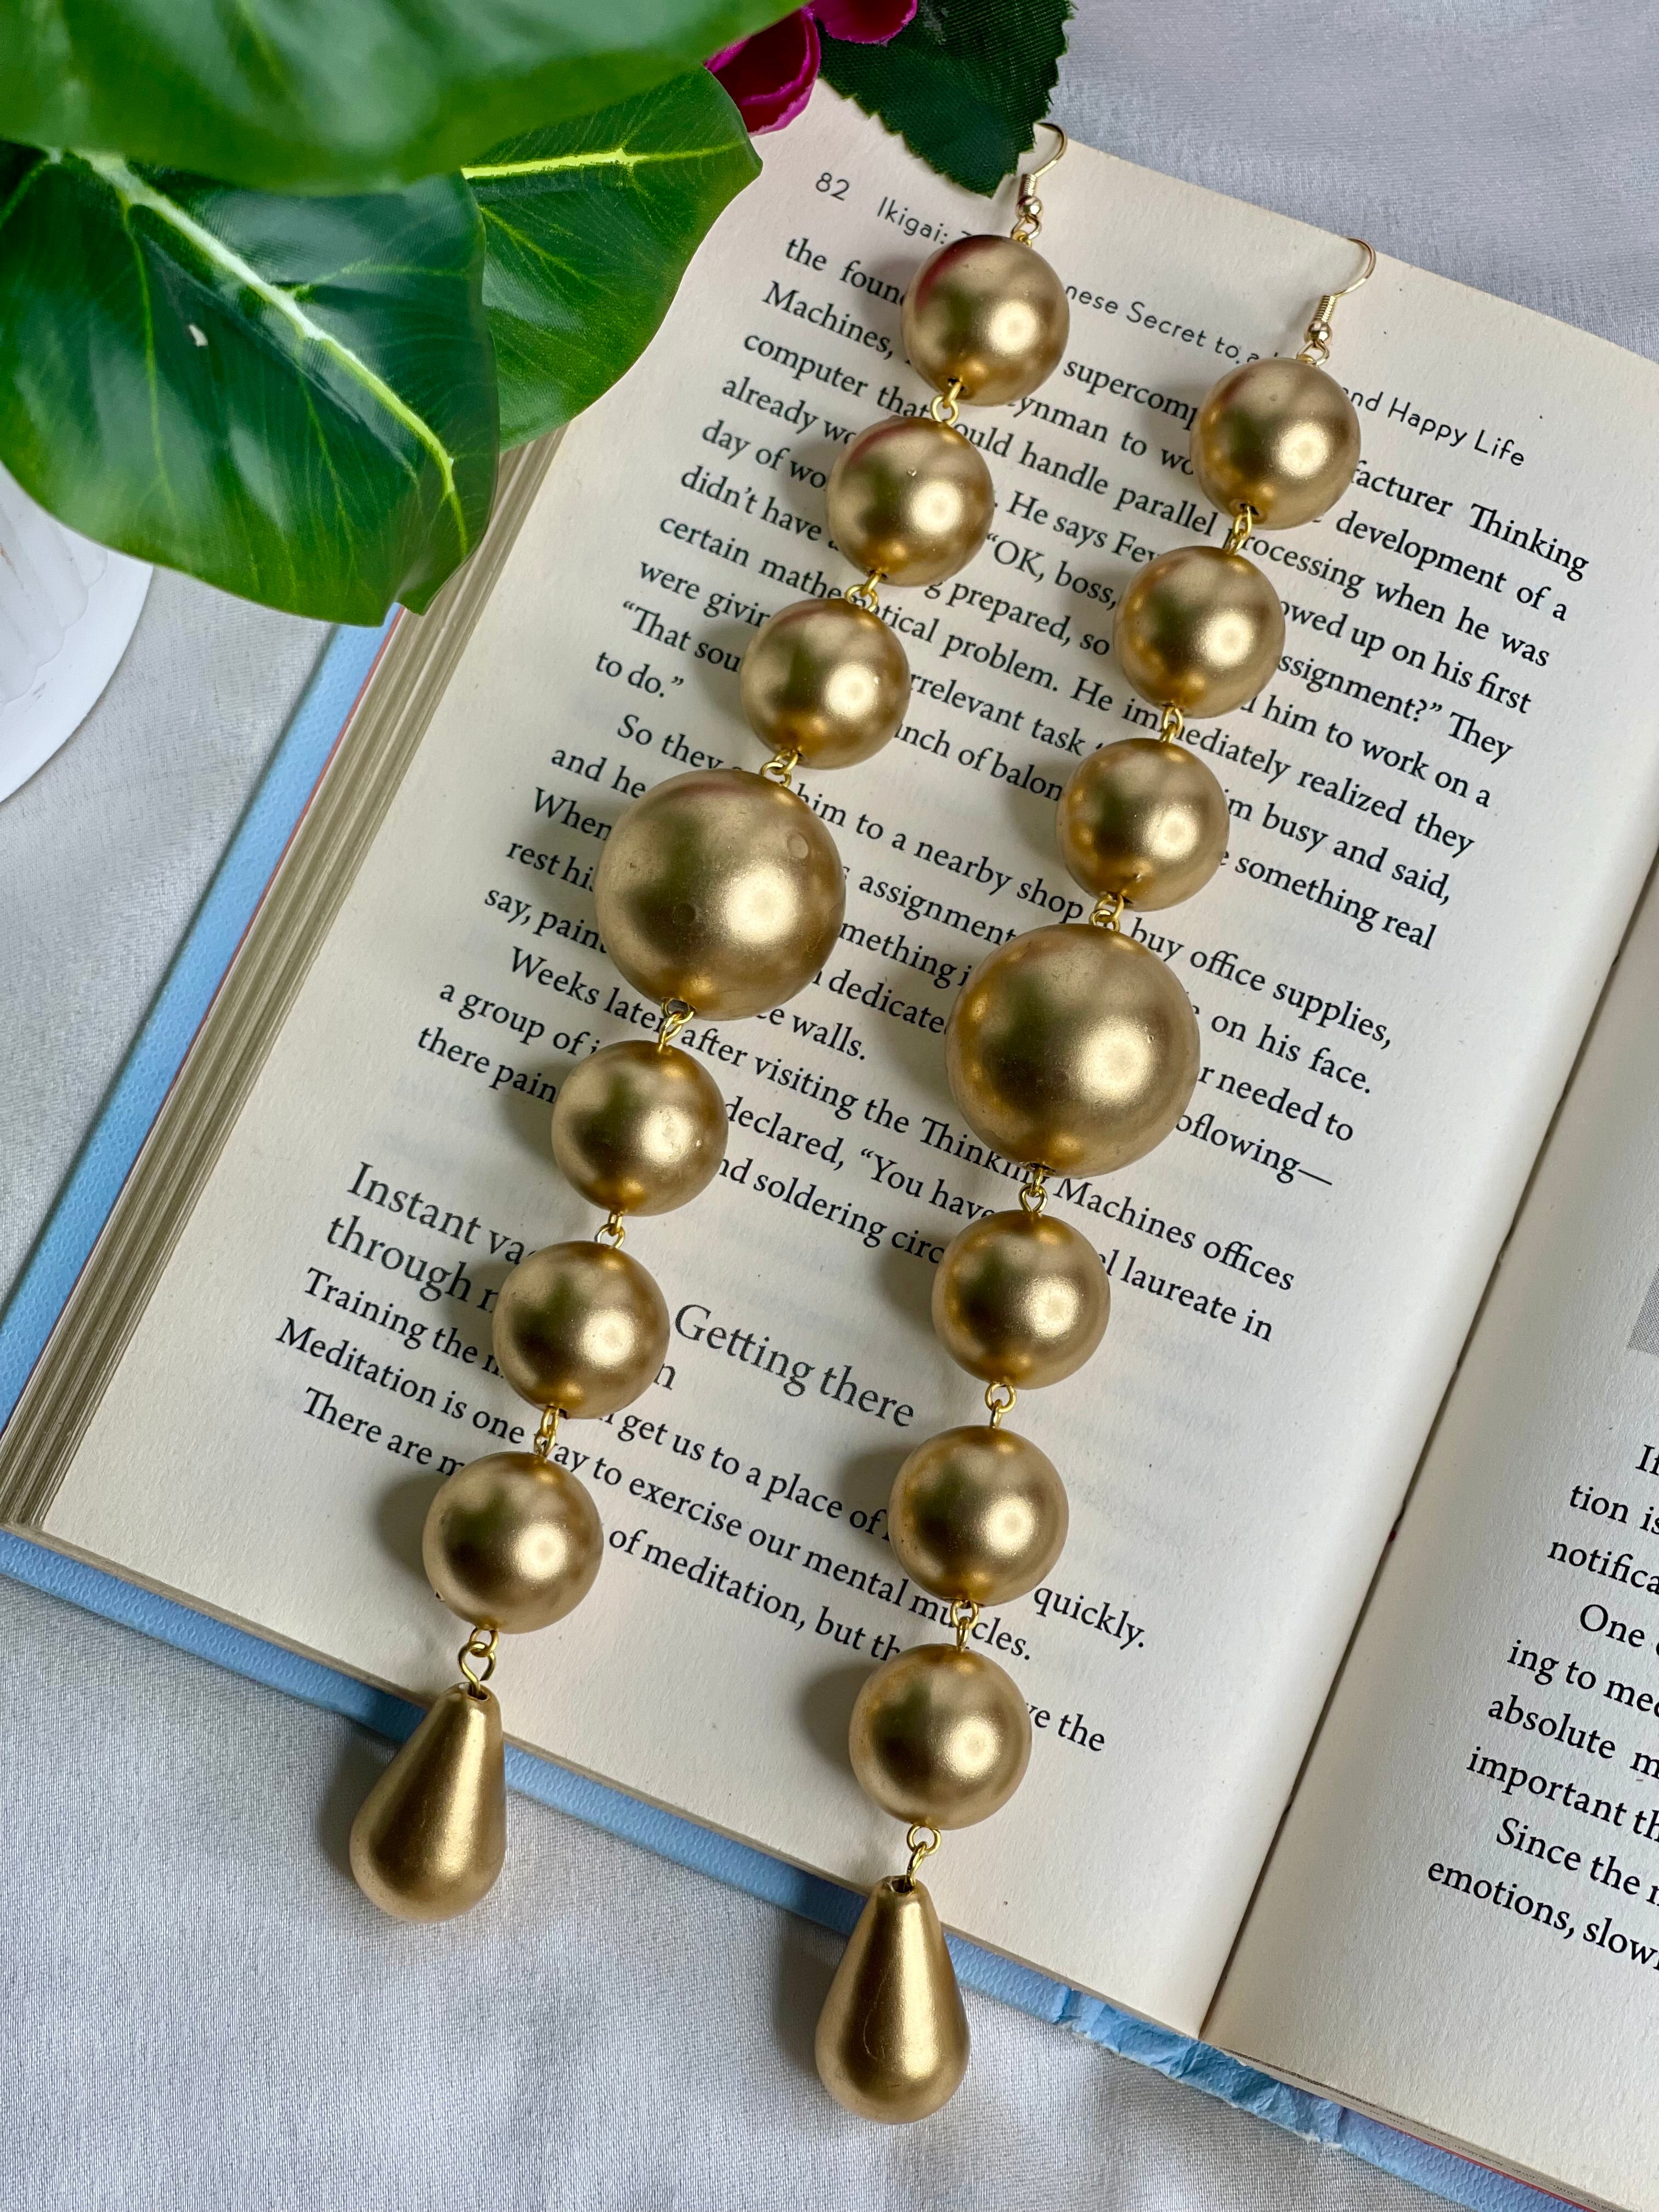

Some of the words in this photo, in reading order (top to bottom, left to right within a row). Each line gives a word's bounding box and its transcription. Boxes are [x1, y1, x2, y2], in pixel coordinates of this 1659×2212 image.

[761, 280, 894, 360] Machines,
[1013, 396, 1108, 444] ynman
[1120, 431, 1148, 456] to
[1335, 510, 1507, 593] development
[1516, 586, 1552, 610] of
[1552, 603, 1567, 622] a
[785, 238, 827, 272] the
[1469, 503, 1590, 582] Thinking
[815, 172, 850, 201] 82
[877, 196, 948, 245] Ikigai:
[1126, 301, 1206, 347] Secret
[1215, 336, 1239, 359] to
[1387, 397, 1468, 447] Happy
[1474, 429, 1525, 466] Life
[595, 652, 623, 678] to
[680, 465, 758, 515] didn’t
[760, 495, 822, 541] have
[945, 583, 1071, 647] prepared,
[1079, 633, 1110, 656] so
[1261, 694, 1317, 737] him
[1325, 723, 1353, 748] to
[1362, 738, 1430, 781] work
[1435, 771, 1469, 798] on
[1475, 789, 1491, 808] a
[702, 419, 751, 460] day
[755, 447, 791, 471] of
[986, 533, 1045, 583] “OK,
[1054, 560, 1117, 611] boss,
[1277, 656, 1443, 723] ssignment?”
[1448, 711, 1514, 765] They
[722, 376, 819, 435] already
[1006, 490, 1048, 525] He
[1053, 516, 1108, 549] says
[1350, 627, 1385, 659] up
[1391, 645, 1426, 670] on
[1430, 650, 1474, 688] his
[1475, 672, 1532, 714] first
[744, 335, 869, 397] computer
[876, 386, 930, 417] that
[952, 422, 1015, 458] ould
[1018, 440, 1109, 495] handle
[1112, 487, 1218, 537] parallel
[1375, 582, 1446, 624] when
[1454, 606, 1489, 640] he
[1502, 631, 1550, 667] was
[622, 601, 692, 651] “That
[957, 747, 994, 771] of
[1234, 857, 1380, 933] something
[1381, 916, 1437, 950] real
[641, 561, 700, 600] were
[703, 592, 771, 629] givin
[910, 674, 1025, 731] rrelevant
[1031, 718, 1086, 757] task
[1261, 802, 1329, 854] busy
[1333, 840, 1389, 873] and
[1391, 864, 1450, 906] said,
[659, 518, 749, 568] certain
[939, 634, 1058, 692] problem.
[1069, 676, 1113, 712] He
[1296, 771, 1408, 825] realized
[1414, 812, 1475, 859] they
[484, 889, 533, 926] say,
[792, 1014, 865, 1060] walls.
[505, 842, 560, 876] rest
[828, 968, 946, 1036] dedicate
[534, 786, 613, 843] When
[838, 922, 957, 989] mething
[1215, 1074, 1324, 1128] needed
[1325, 1113, 1353, 1141] to
[551, 749, 608, 782] and
[610, 765, 646, 799] he
[859, 876, 1017, 946] assignment
[1211, 1015, 1246, 1042] on
[1255, 1023, 1301, 1062] his
[1307, 1047, 1370, 1094] face.
[617, 714, 653, 746] So
[855, 814, 884, 840] to
[891, 833, 907, 851] a
[913, 842, 1014, 896] nearby
[1016, 877, 1084, 923] shop
[1130, 917, 1185, 962] buy
[1189, 950, 1266, 991] office
[1272, 983, 1391, 1050] supplies,
[327, 1214, 472, 1303] through
[417, 1026, 490, 1074] there
[718, 1157, 754, 1184] nd
[753, 1174, 888, 1248] soldering
[439, 984, 455, 1003] a
[457, 994, 545, 1046] group
[552, 1031, 591, 1056] of
[725, 1095, 844, 1171] declared,
[860, 1148, 924, 1198] “You
[1120, 1255, 1237, 1324] laureate
[1242, 1309, 1272, 1342] in
[512, 946, 600, 1005] Weeks
[603, 986, 665, 1034] later
[680, 1026, 748, 1067] after
[755, 1057, 859, 1121] visiting
[864, 1098, 910, 1133] the
[919, 1116, 1049, 1187] Thinkin
[1052, 1176, 1197, 1249] Machines
[1203, 1240, 1295, 1290] offices
[304, 1266, 429, 1350] Training
[432, 1327, 478, 1364] the
[617, 1415, 669, 1446] get
[672, 1434, 706, 1462] us
[710, 1447, 740, 1475] to
[746, 1467, 761, 1487] a
[761, 1472, 843, 1519] place
[849, 1508, 888, 1536] of
[1033, 1587, 1145, 1651] quickly.
[347, 1161, 482, 1245] Instant
[674, 1304, 816, 1397] Getting
[820, 1364, 914, 1427] there
[275, 1316, 437, 1408] Meditation
[439, 1390, 468, 1419] is
[472, 1410, 525, 1444] one
[592, 1457, 622, 1486] to
[628, 1478, 742, 1537] exercise
[748, 1528, 802, 1561] our
[802, 1550, 909, 1607] mental
[907, 1594, 1030, 1661] mucles.
[303, 1386, 382, 1443] There
[387, 1435, 433, 1465] are
[608, 1528, 648, 1555] of
[641, 1544, 805, 1632] meditation,
[814, 1605, 867, 1650] but
[1058, 1713, 1105, 1752] the
[1547, 1542, 1659, 1595] notifica
[1570, 1485, 1629, 1525] tion
[1579, 1604, 1645, 1648] One
[1466, 1746, 1628, 1827] important
[1488, 1694, 1616, 1759] absolute
[1506, 1639, 1560, 1686] ing
[1565, 1661, 1596, 1690] to
[1427, 1863, 1575, 1940] emotions,
[1582, 1917, 1659, 1971] slow
[1496, 1817, 1582, 1871] Since
[1589, 1854, 1640, 1895] the
